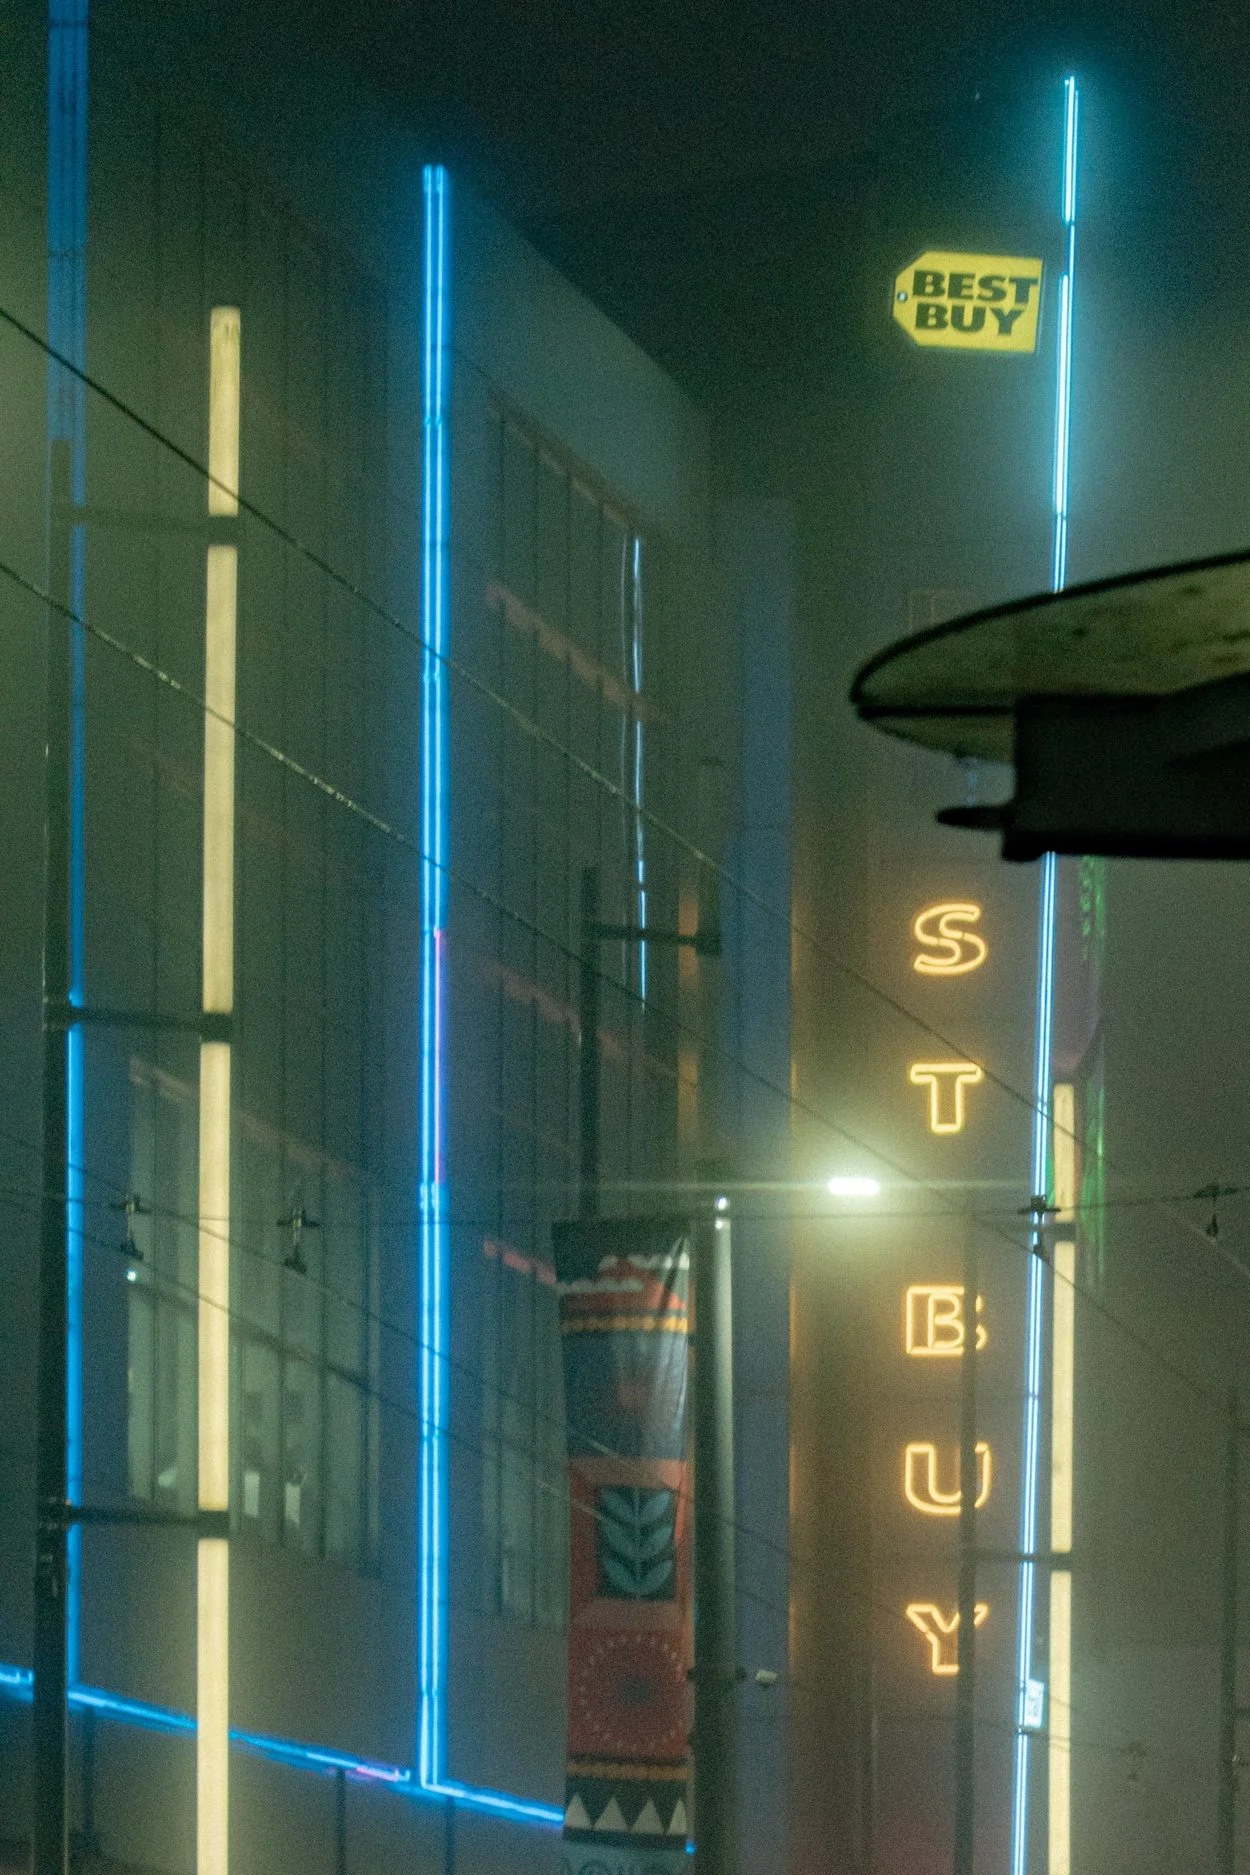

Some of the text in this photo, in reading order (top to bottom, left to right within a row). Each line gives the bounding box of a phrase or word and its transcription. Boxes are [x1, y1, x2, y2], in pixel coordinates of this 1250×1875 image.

[912, 269, 1039, 305] BEST
[915, 301, 1024, 336] BUY
[905, 1285, 990, 1674] BUY
